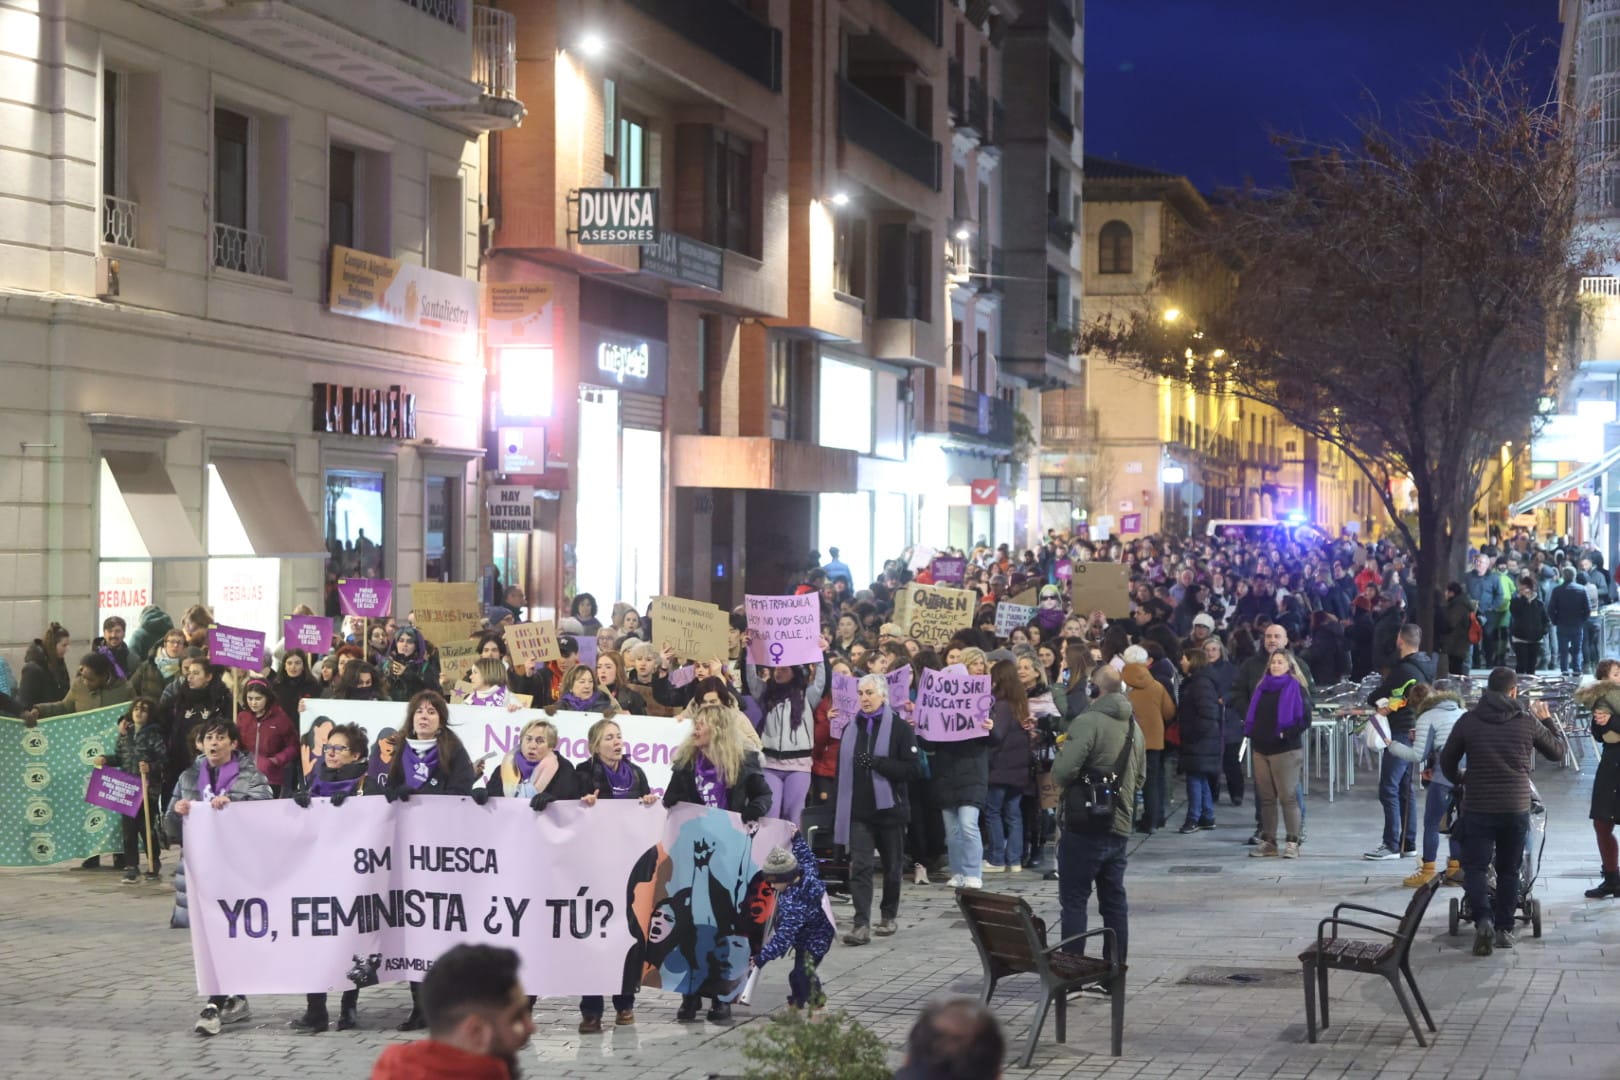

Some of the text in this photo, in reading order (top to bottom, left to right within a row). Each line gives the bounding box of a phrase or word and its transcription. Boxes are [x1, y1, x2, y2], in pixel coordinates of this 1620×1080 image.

[580, 191, 654, 227] DUVISA
[581, 229, 654, 241] ASESORES
[420, 295, 469, 324] Santaliestra
[501, 490, 521, 502] HAY
[490, 505, 531, 517] LOTERIA
[489, 519, 532, 531] NACIONAL
[98, 588, 147, 608] REBAJAS
[223, 585, 264, 602] REBAJAS
[913, 588, 968, 611] QUIEREN
[777, 616, 793, 626] VOY
[793, 614, 815, 625] SOLA
[774, 629, 803, 641] CALLE
[921, 672, 934, 690] NO
[935, 676, 959, 696] SOY
[921, 691, 972, 709] BÚSCATE
[917, 709, 930, 731] LA
[484, 724, 521, 753] Ni
[353, 844, 499, 875] 8M HUESCA
[216, 886, 615, 943] YO, FEMINISTA ¿Y TÚ?
[384, 957, 435, 972] ASAMBLE
